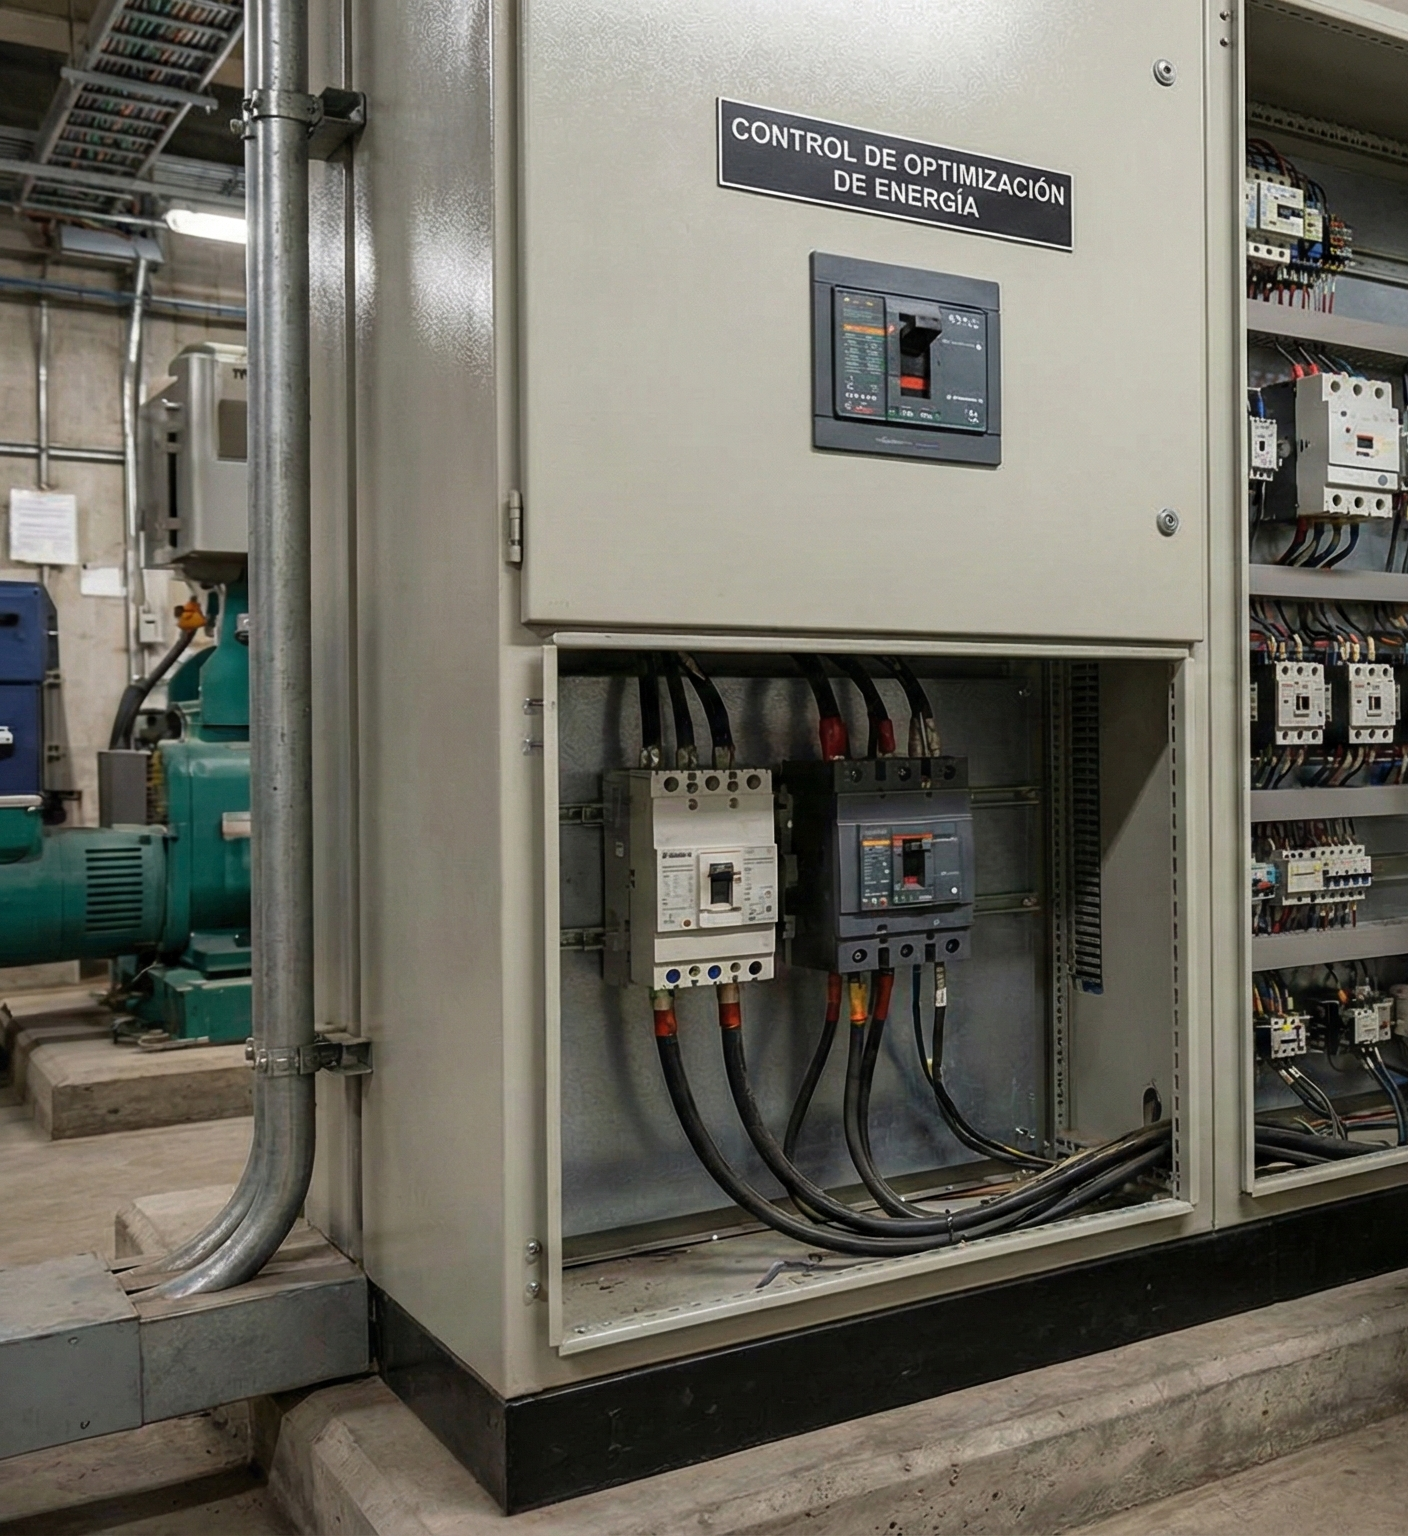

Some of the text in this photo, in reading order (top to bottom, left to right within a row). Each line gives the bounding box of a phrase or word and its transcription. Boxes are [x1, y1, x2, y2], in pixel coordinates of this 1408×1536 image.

[731, 117, 1065, 206] CONTROL DE OPTIMIZACIÓN
[833, 169, 980, 218] DE ENERGÍA
